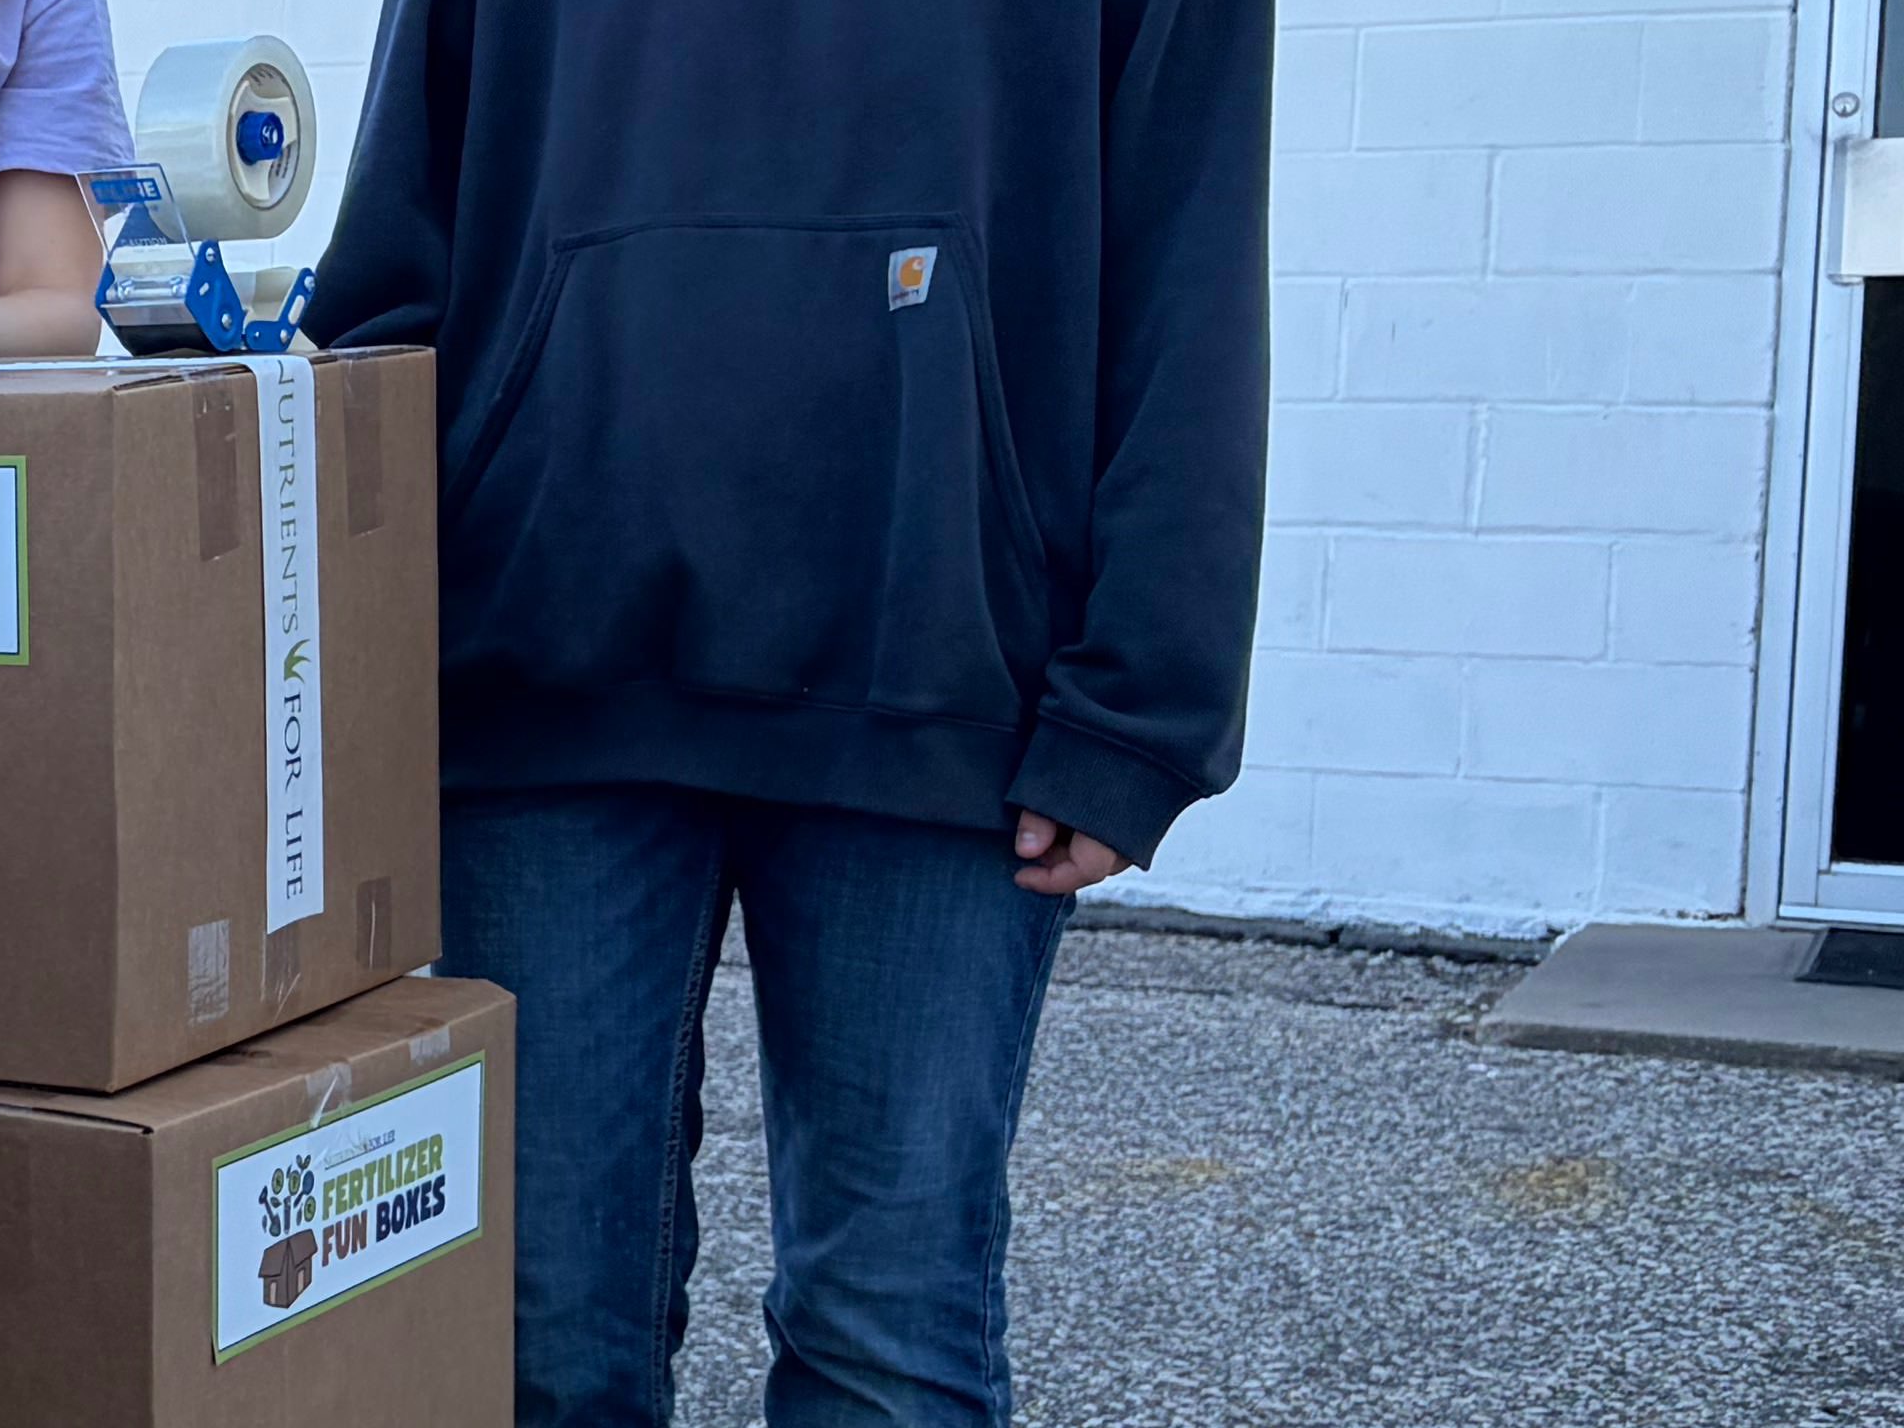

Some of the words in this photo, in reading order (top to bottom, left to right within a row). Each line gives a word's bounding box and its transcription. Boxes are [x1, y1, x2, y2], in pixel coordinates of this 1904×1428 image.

[283, 692, 303, 793] FOR
[286, 808, 304, 901] LIFE
[321, 1209, 368, 1268] FUN
[376, 1174, 446, 1243] BOXES
[322, 1133, 444, 1221] FERTILIZER
